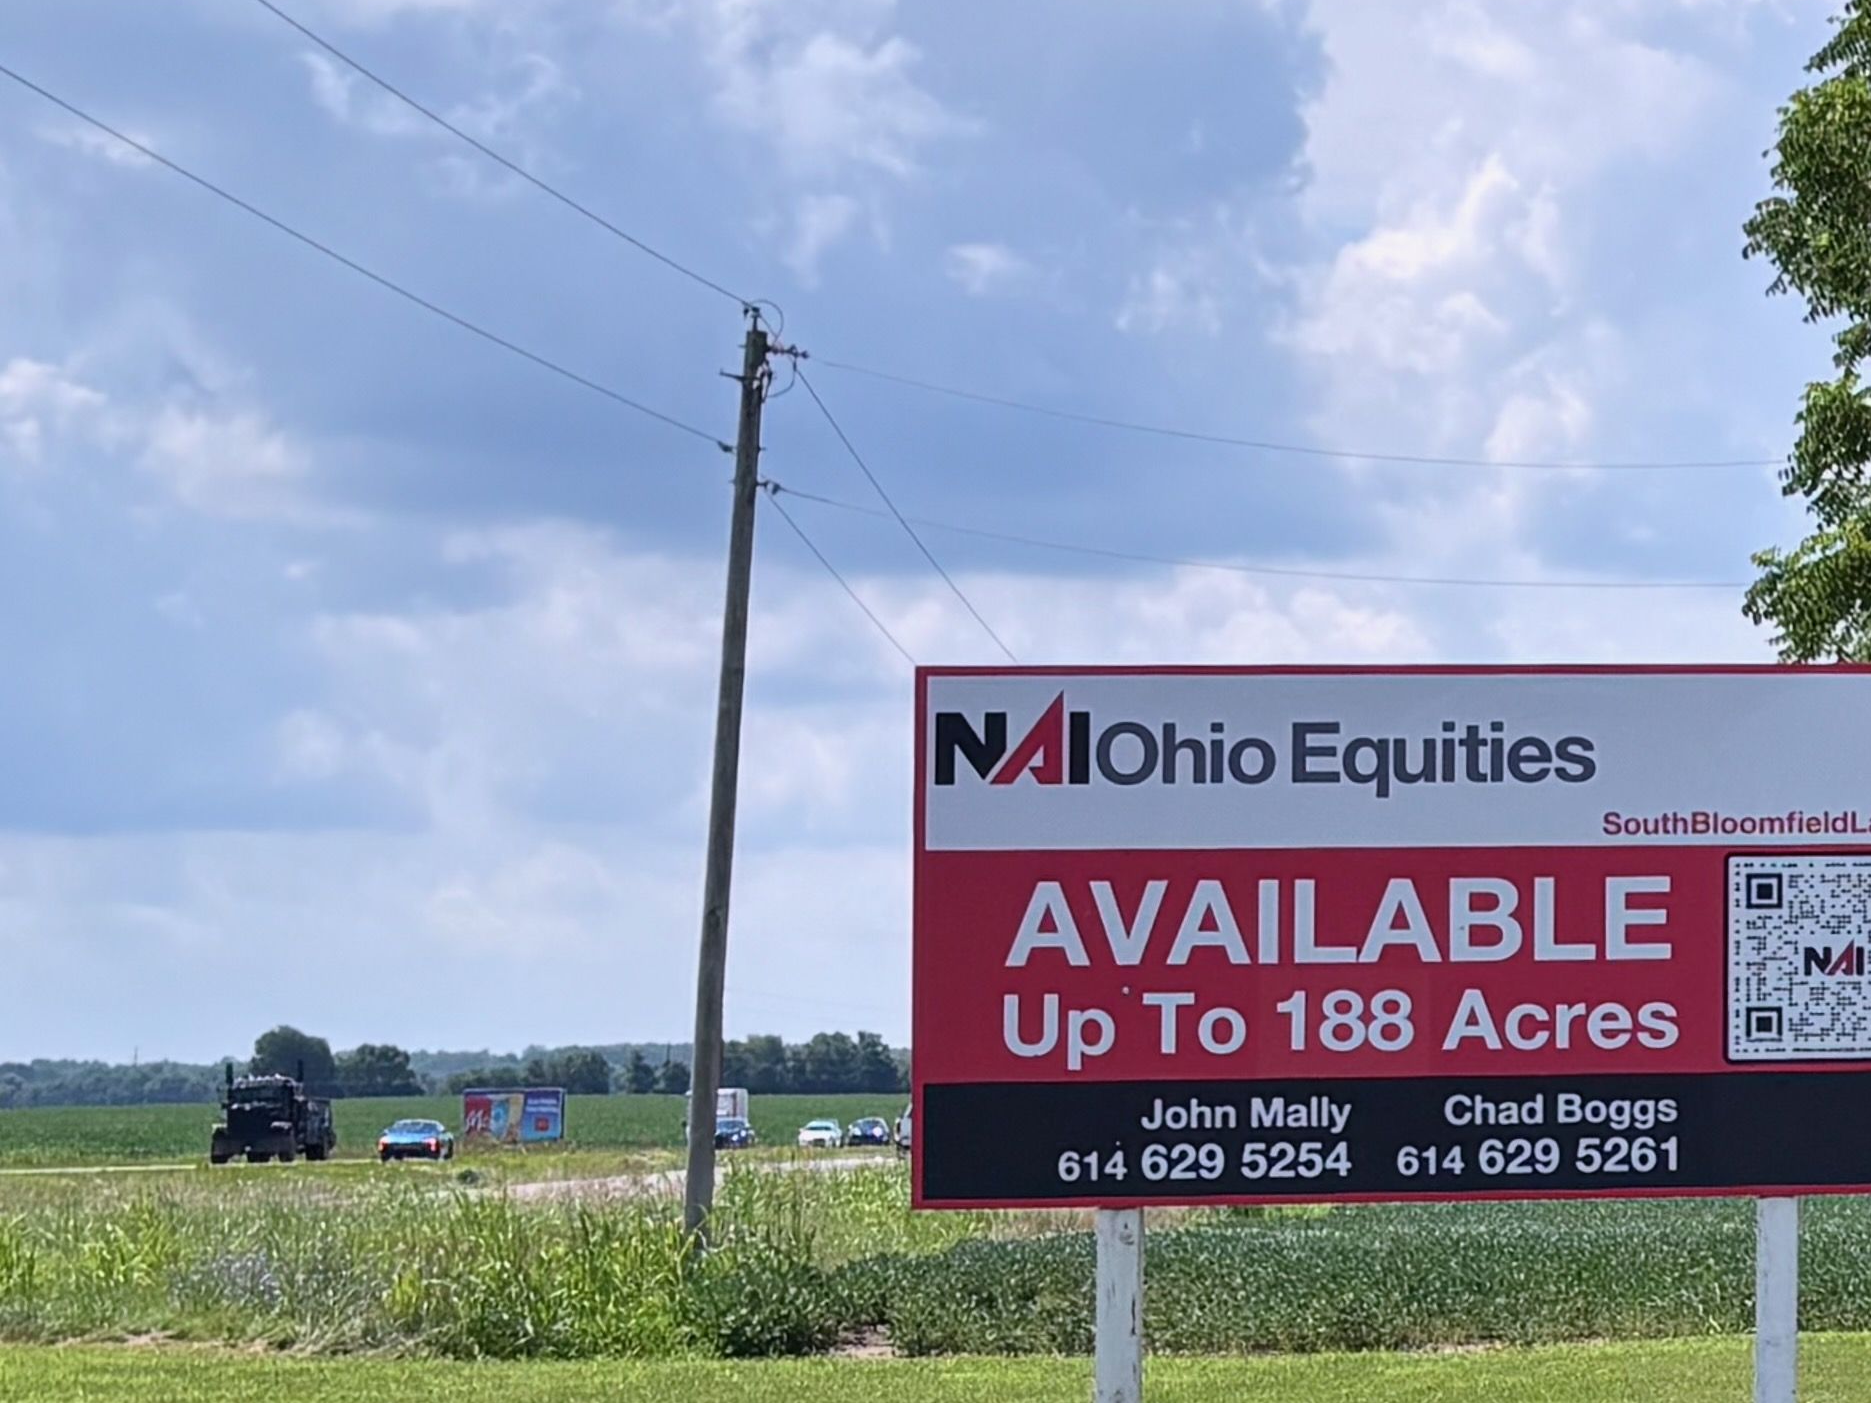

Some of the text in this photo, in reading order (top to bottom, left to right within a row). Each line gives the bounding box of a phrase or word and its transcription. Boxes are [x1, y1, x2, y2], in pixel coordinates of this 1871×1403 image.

[1292, 721, 1596, 798] Equities
[1006, 877, 1672, 967] AVAILABLE
[1803, 939, 1865, 976] NAI
[1004, 989, 1679, 1070] Up To 188 Acres
[1142, 1097, 1352, 1134] John Mally
[1444, 1093, 1678, 1130] Chad Boggs
[1058, 1142, 1352, 1181] 614 629 5254
[1397, 1137, 1677, 1176] 614 629 5261
